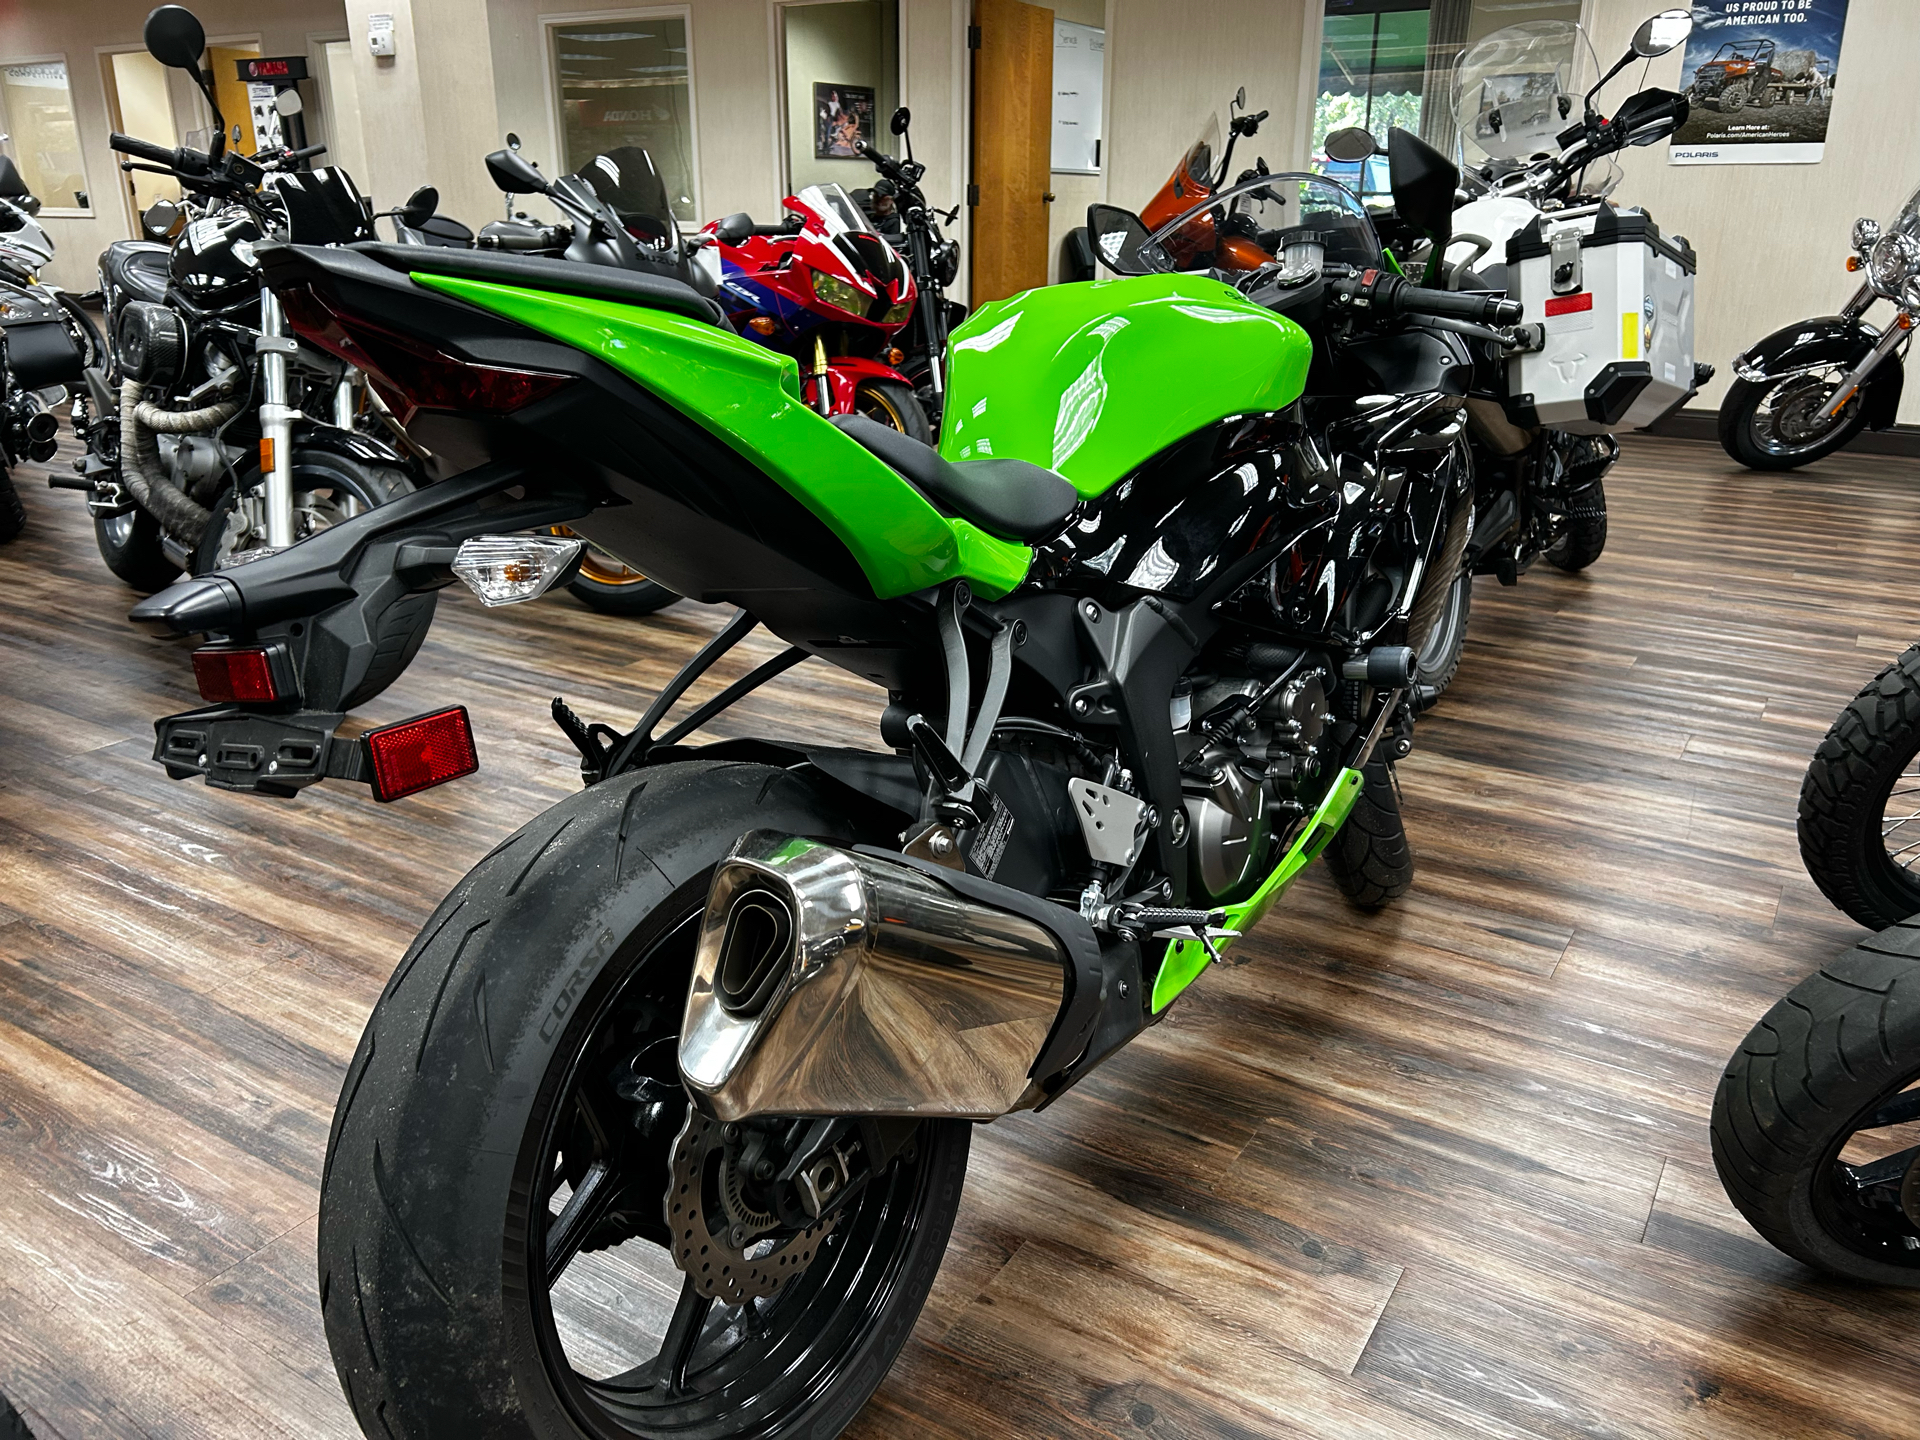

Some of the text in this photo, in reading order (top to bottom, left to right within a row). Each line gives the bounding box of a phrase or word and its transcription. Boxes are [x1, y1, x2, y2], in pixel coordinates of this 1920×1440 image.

[1725, 0, 1813, 13] US PROUD TO BE
[1725, 12, 1808, 26] AMERICAN TOO.
[257, 62, 289, 75] YAMAHA
[1706, 131, 1790, 139] Polaris.com/AmericanHeroes
[636, 252, 681, 266] SUZU
[539, 927, 615, 1044] CORSA
[909, 1214, 946, 1302] ROSSO
